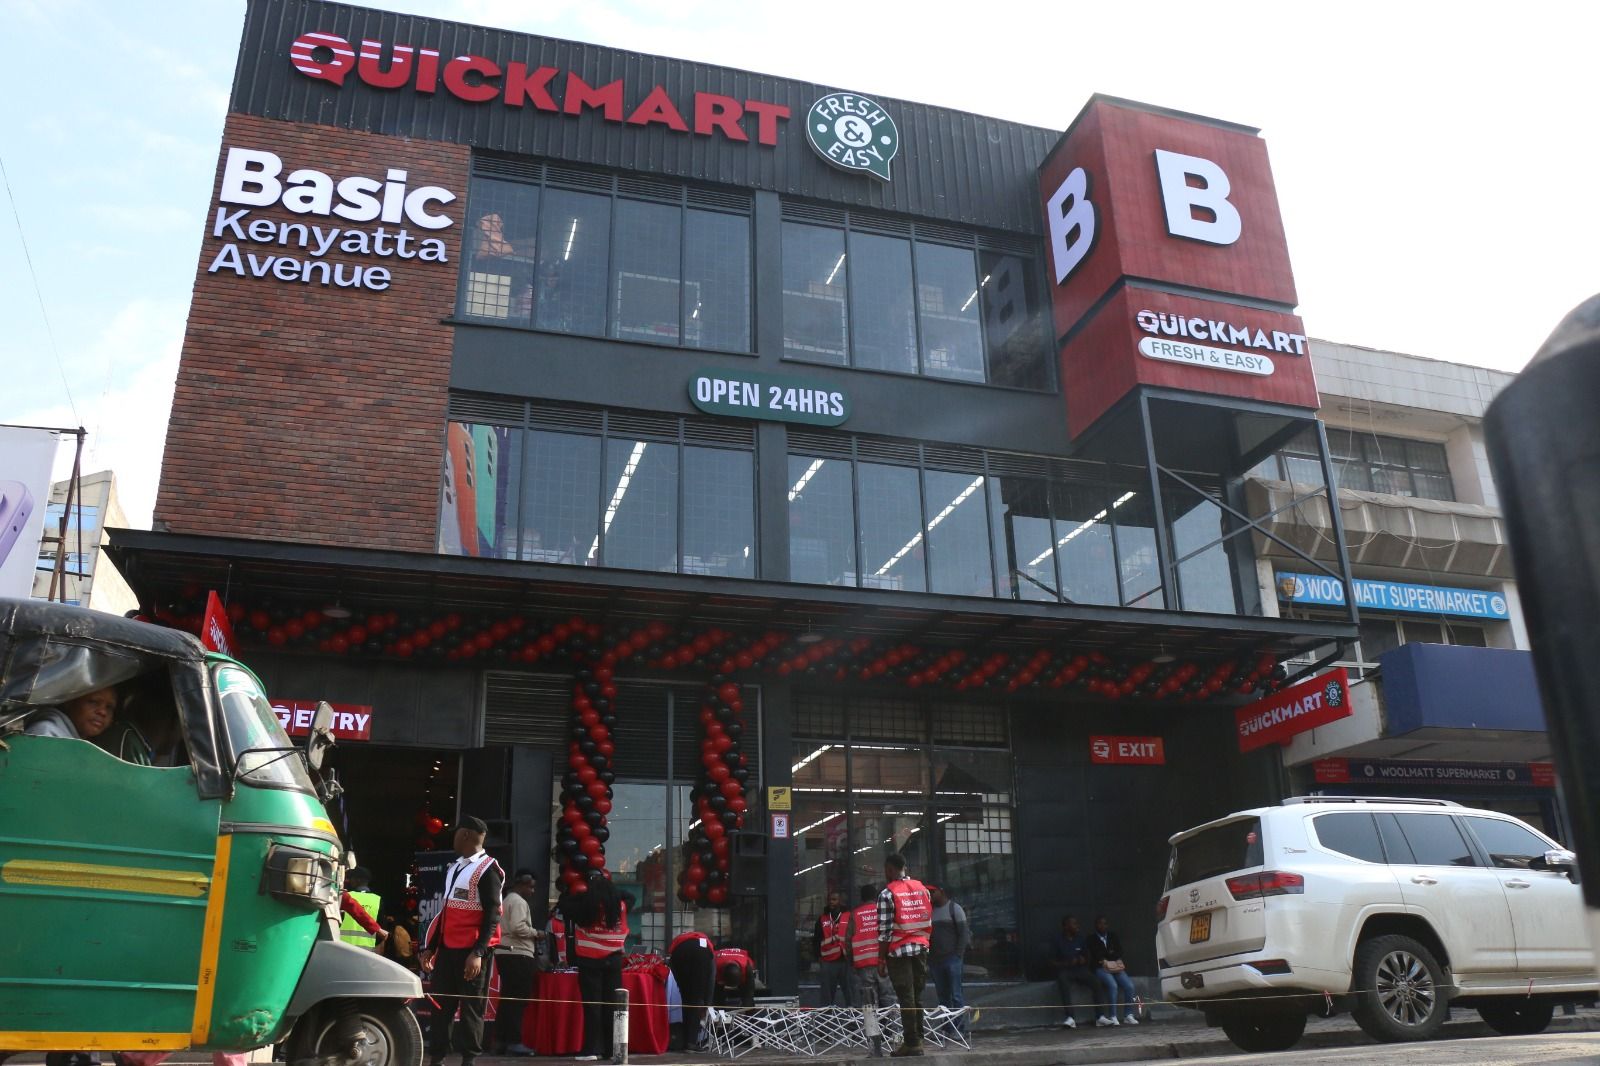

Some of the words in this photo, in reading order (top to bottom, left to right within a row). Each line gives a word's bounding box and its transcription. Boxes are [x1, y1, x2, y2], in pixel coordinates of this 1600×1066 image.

[290, 31, 791, 146] QUICKMART
[816, 96, 886, 126] FRESH
[843, 120, 865, 144] &
[827, 141, 884, 166] EASY
[220, 147, 457, 229] Basic
[1155, 148, 1242, 245] B
[213, 206, 449, 263] Kenyatta
[1047, 167, 1096, 286] B
[208, 243, 391, 290] Avenue
[1136, 309, 1307, 355] QUICKMART
[1151, 341, 1205, 361] FRESH
[1209, 350, 1220, 363] &
[1224, 353, 1264, 371] EASY
[696, 376, 760, 408] OPEN
[769, 386, 844, 417] 24HRS
[1306, 577, 1387, 606] WOOMATT
[1390, 586, 1489, 614] SUPERMARKET
[295, 709, 370, 732] ETRY
[1240, 691, 1322, 737] QUICKMART
[1118, 742, 1156, 757] EXIT
[1380, 767, 1434, 778] WOOLMATT
[1436, 767, 1500, 780] SUPERMARKET
